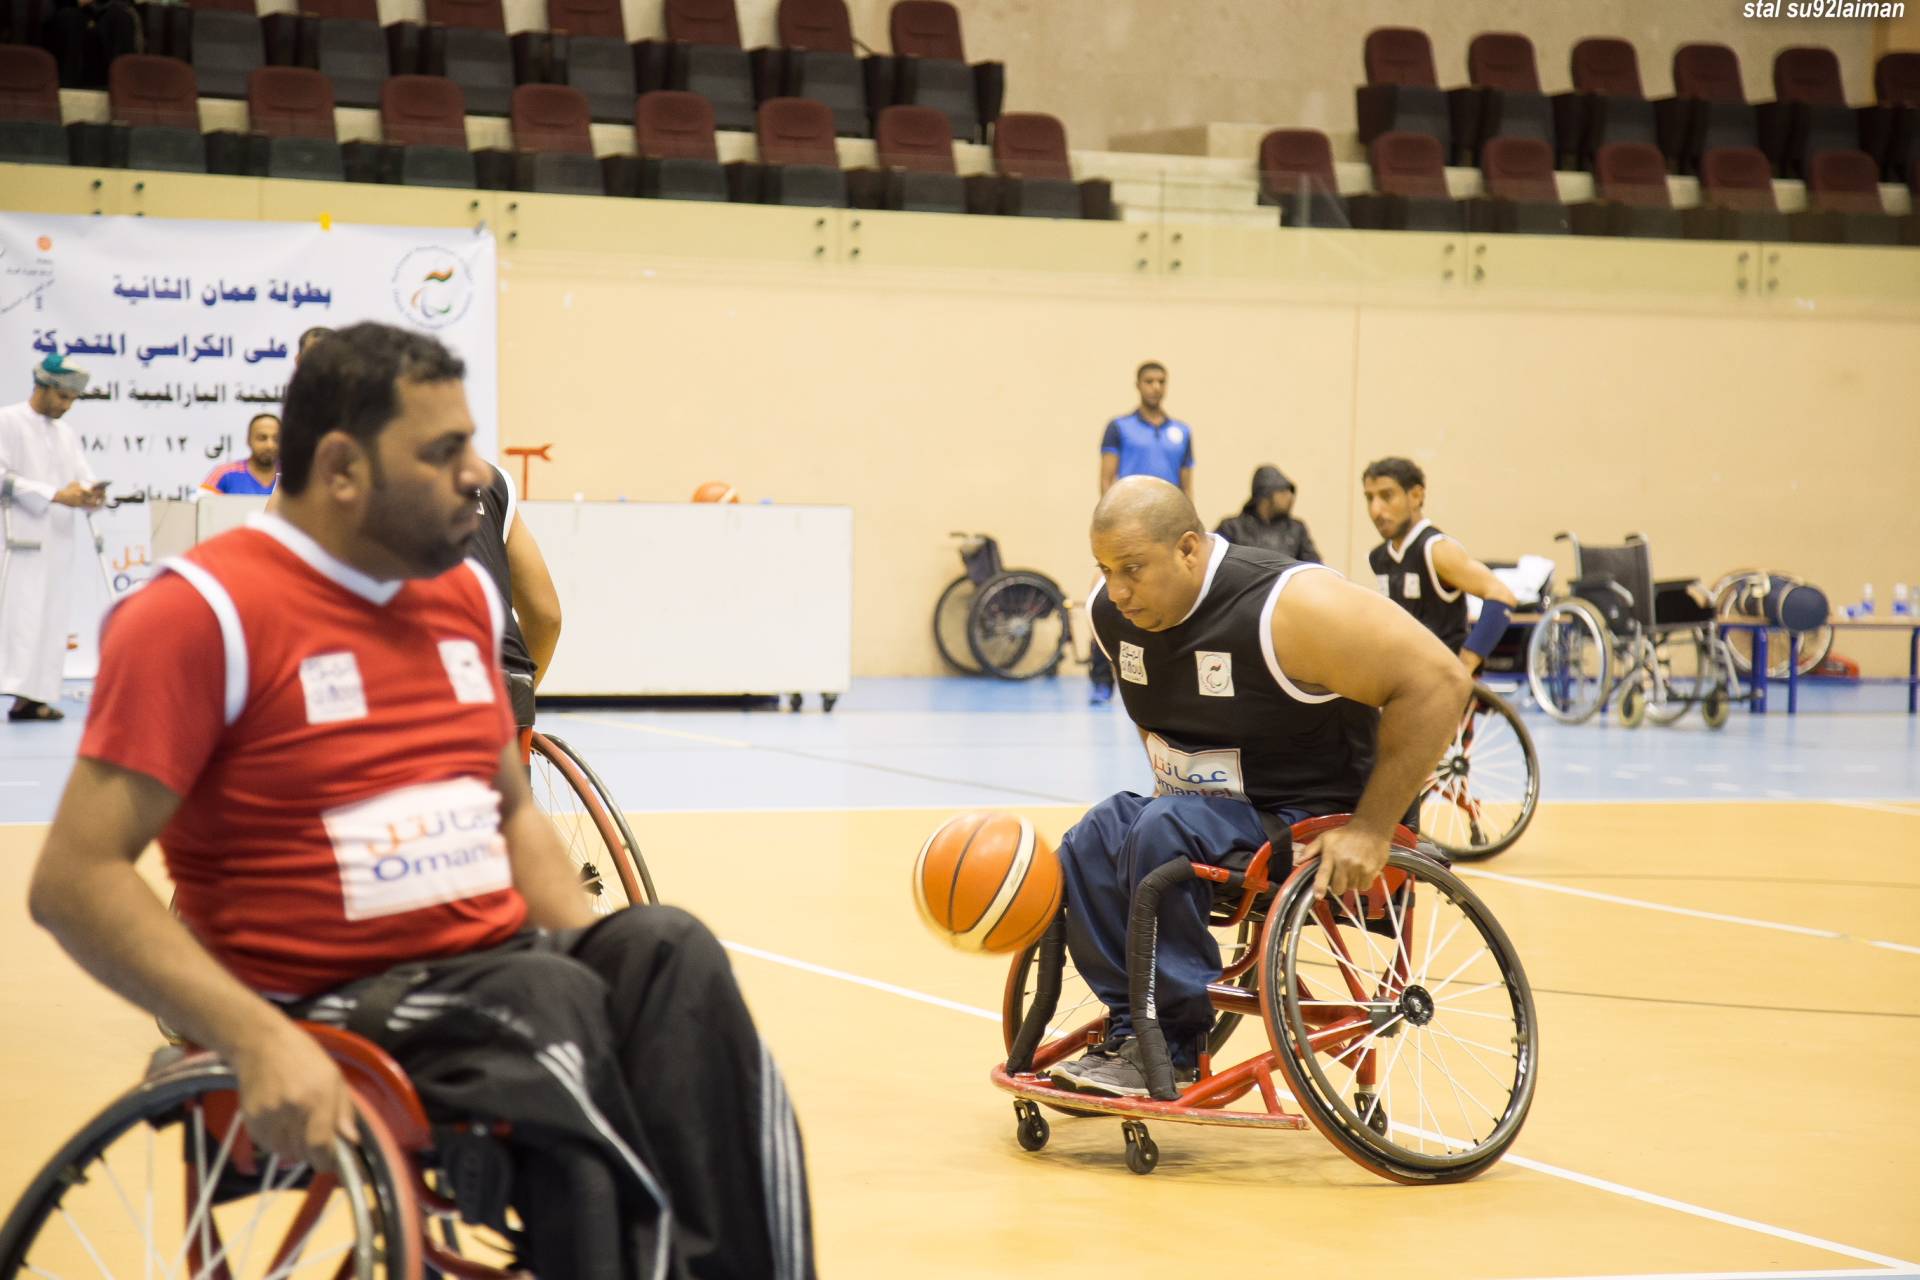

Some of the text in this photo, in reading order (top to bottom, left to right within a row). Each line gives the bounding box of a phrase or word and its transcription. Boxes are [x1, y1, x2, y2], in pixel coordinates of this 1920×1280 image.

[113, 274, 332, 310] بطولة عمان الثانية
[32, 328, 288, 368] على الكراسي المتحركة
[76, 380, 119, 402] العم
[234, 382, 289, 408] للجنة
[373, 842, 504, 882] Oman
